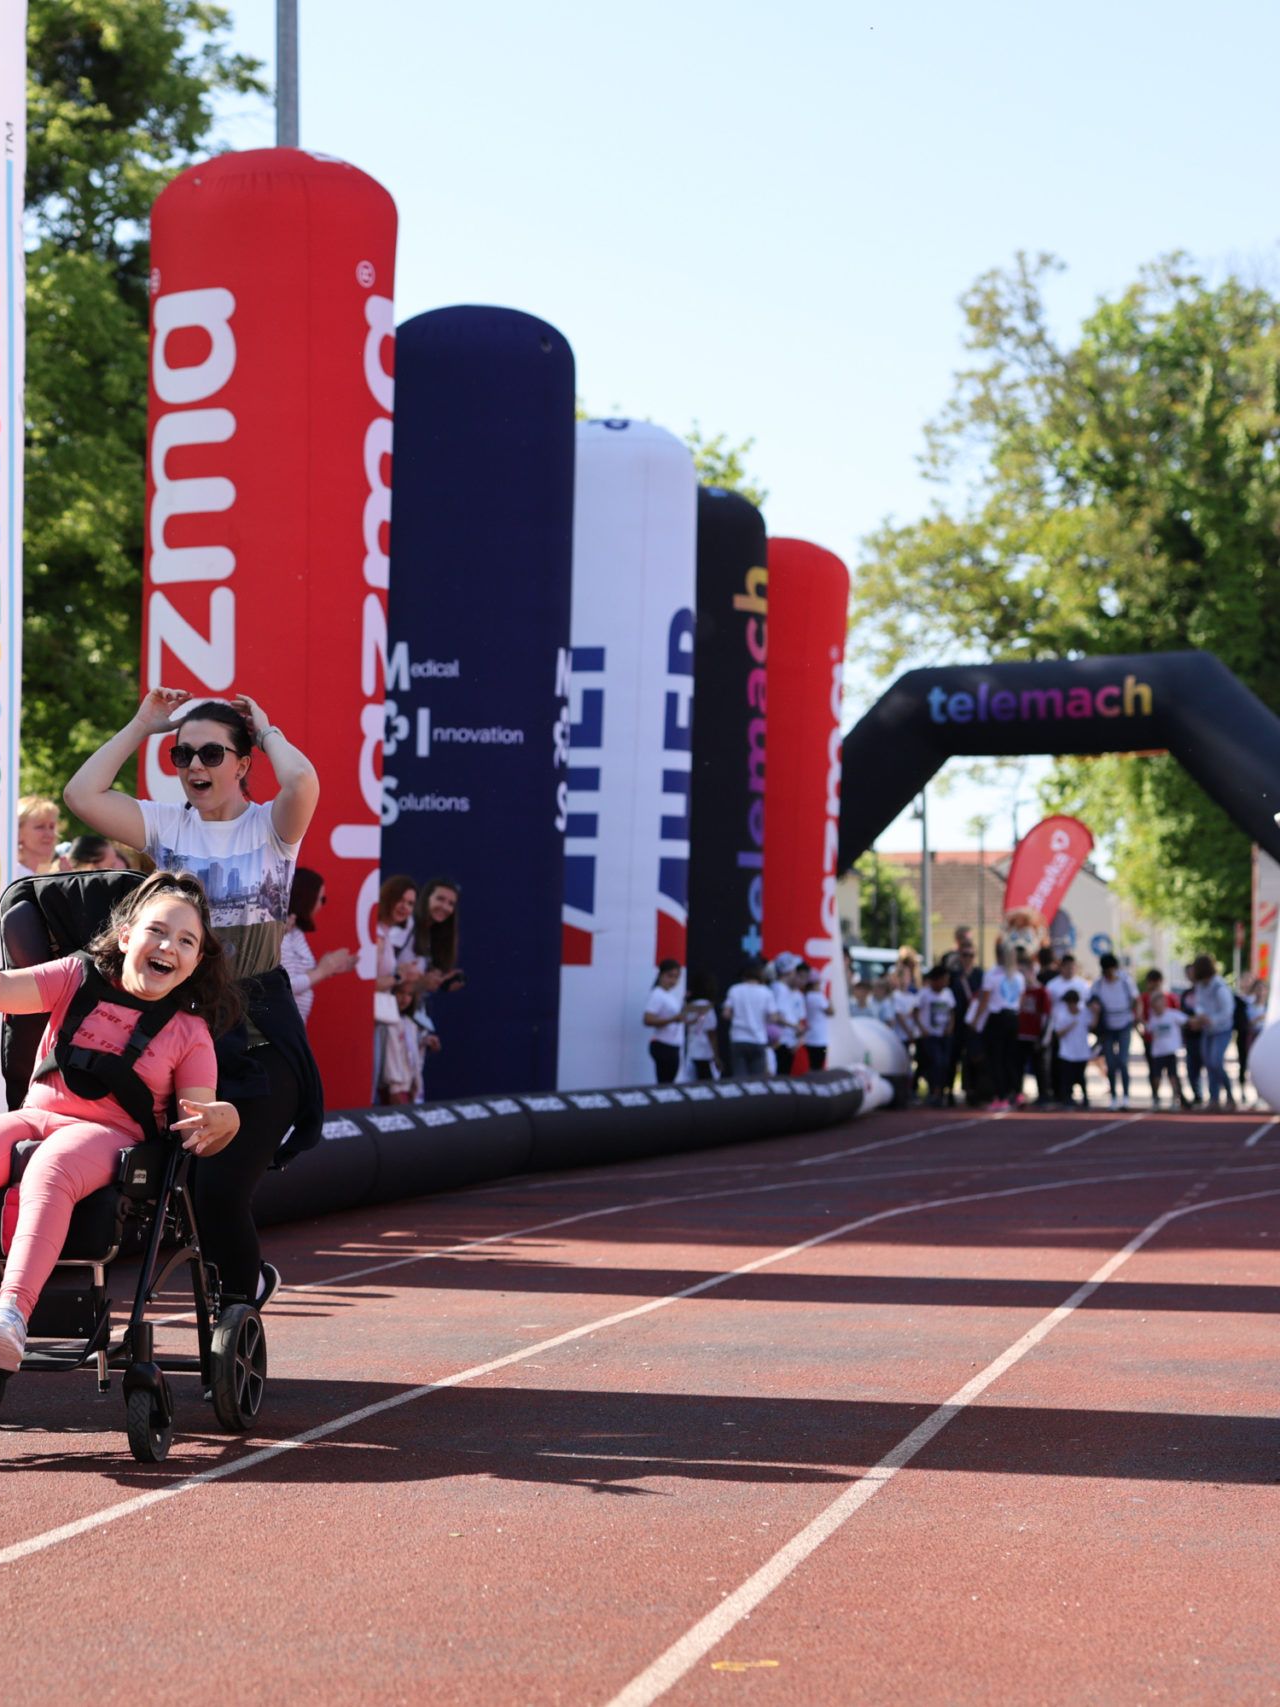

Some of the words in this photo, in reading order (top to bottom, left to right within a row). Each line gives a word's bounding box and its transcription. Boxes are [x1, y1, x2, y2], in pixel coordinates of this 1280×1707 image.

[927, 674, 1153, 724] telemach
[416, 707, 524, 758] Innovation
[380, 775, 470, 827] Solutions
